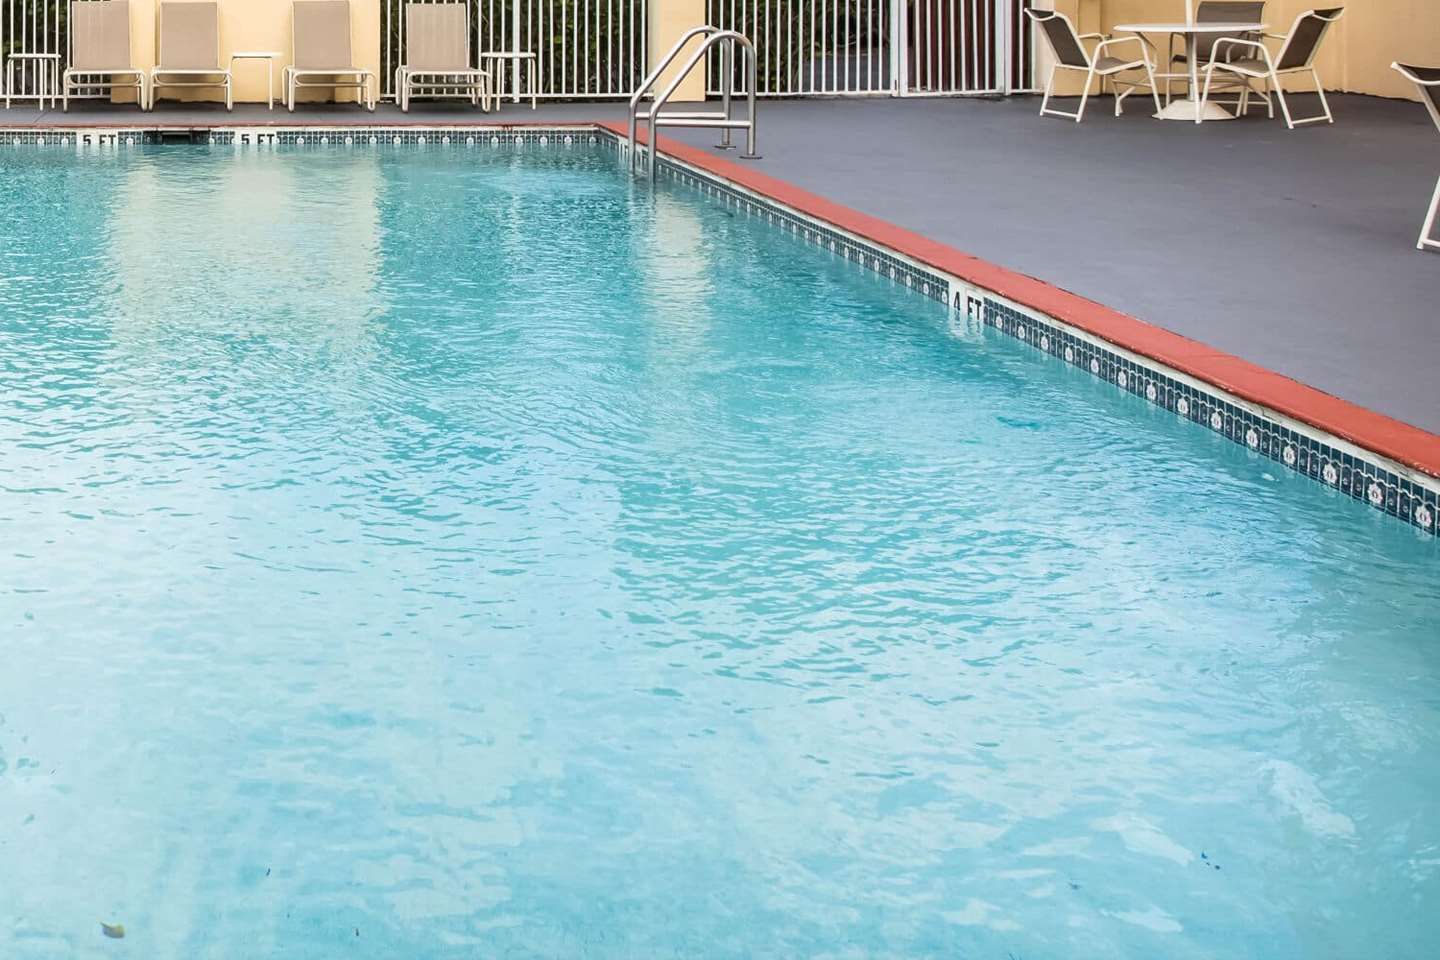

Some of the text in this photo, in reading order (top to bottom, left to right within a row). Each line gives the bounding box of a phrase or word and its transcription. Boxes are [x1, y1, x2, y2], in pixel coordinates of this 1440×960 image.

[83, 134, 117, 145] 5 FT
[241, 133, 275, 145] 5 FT
[967, 295, 982, 320] FT
